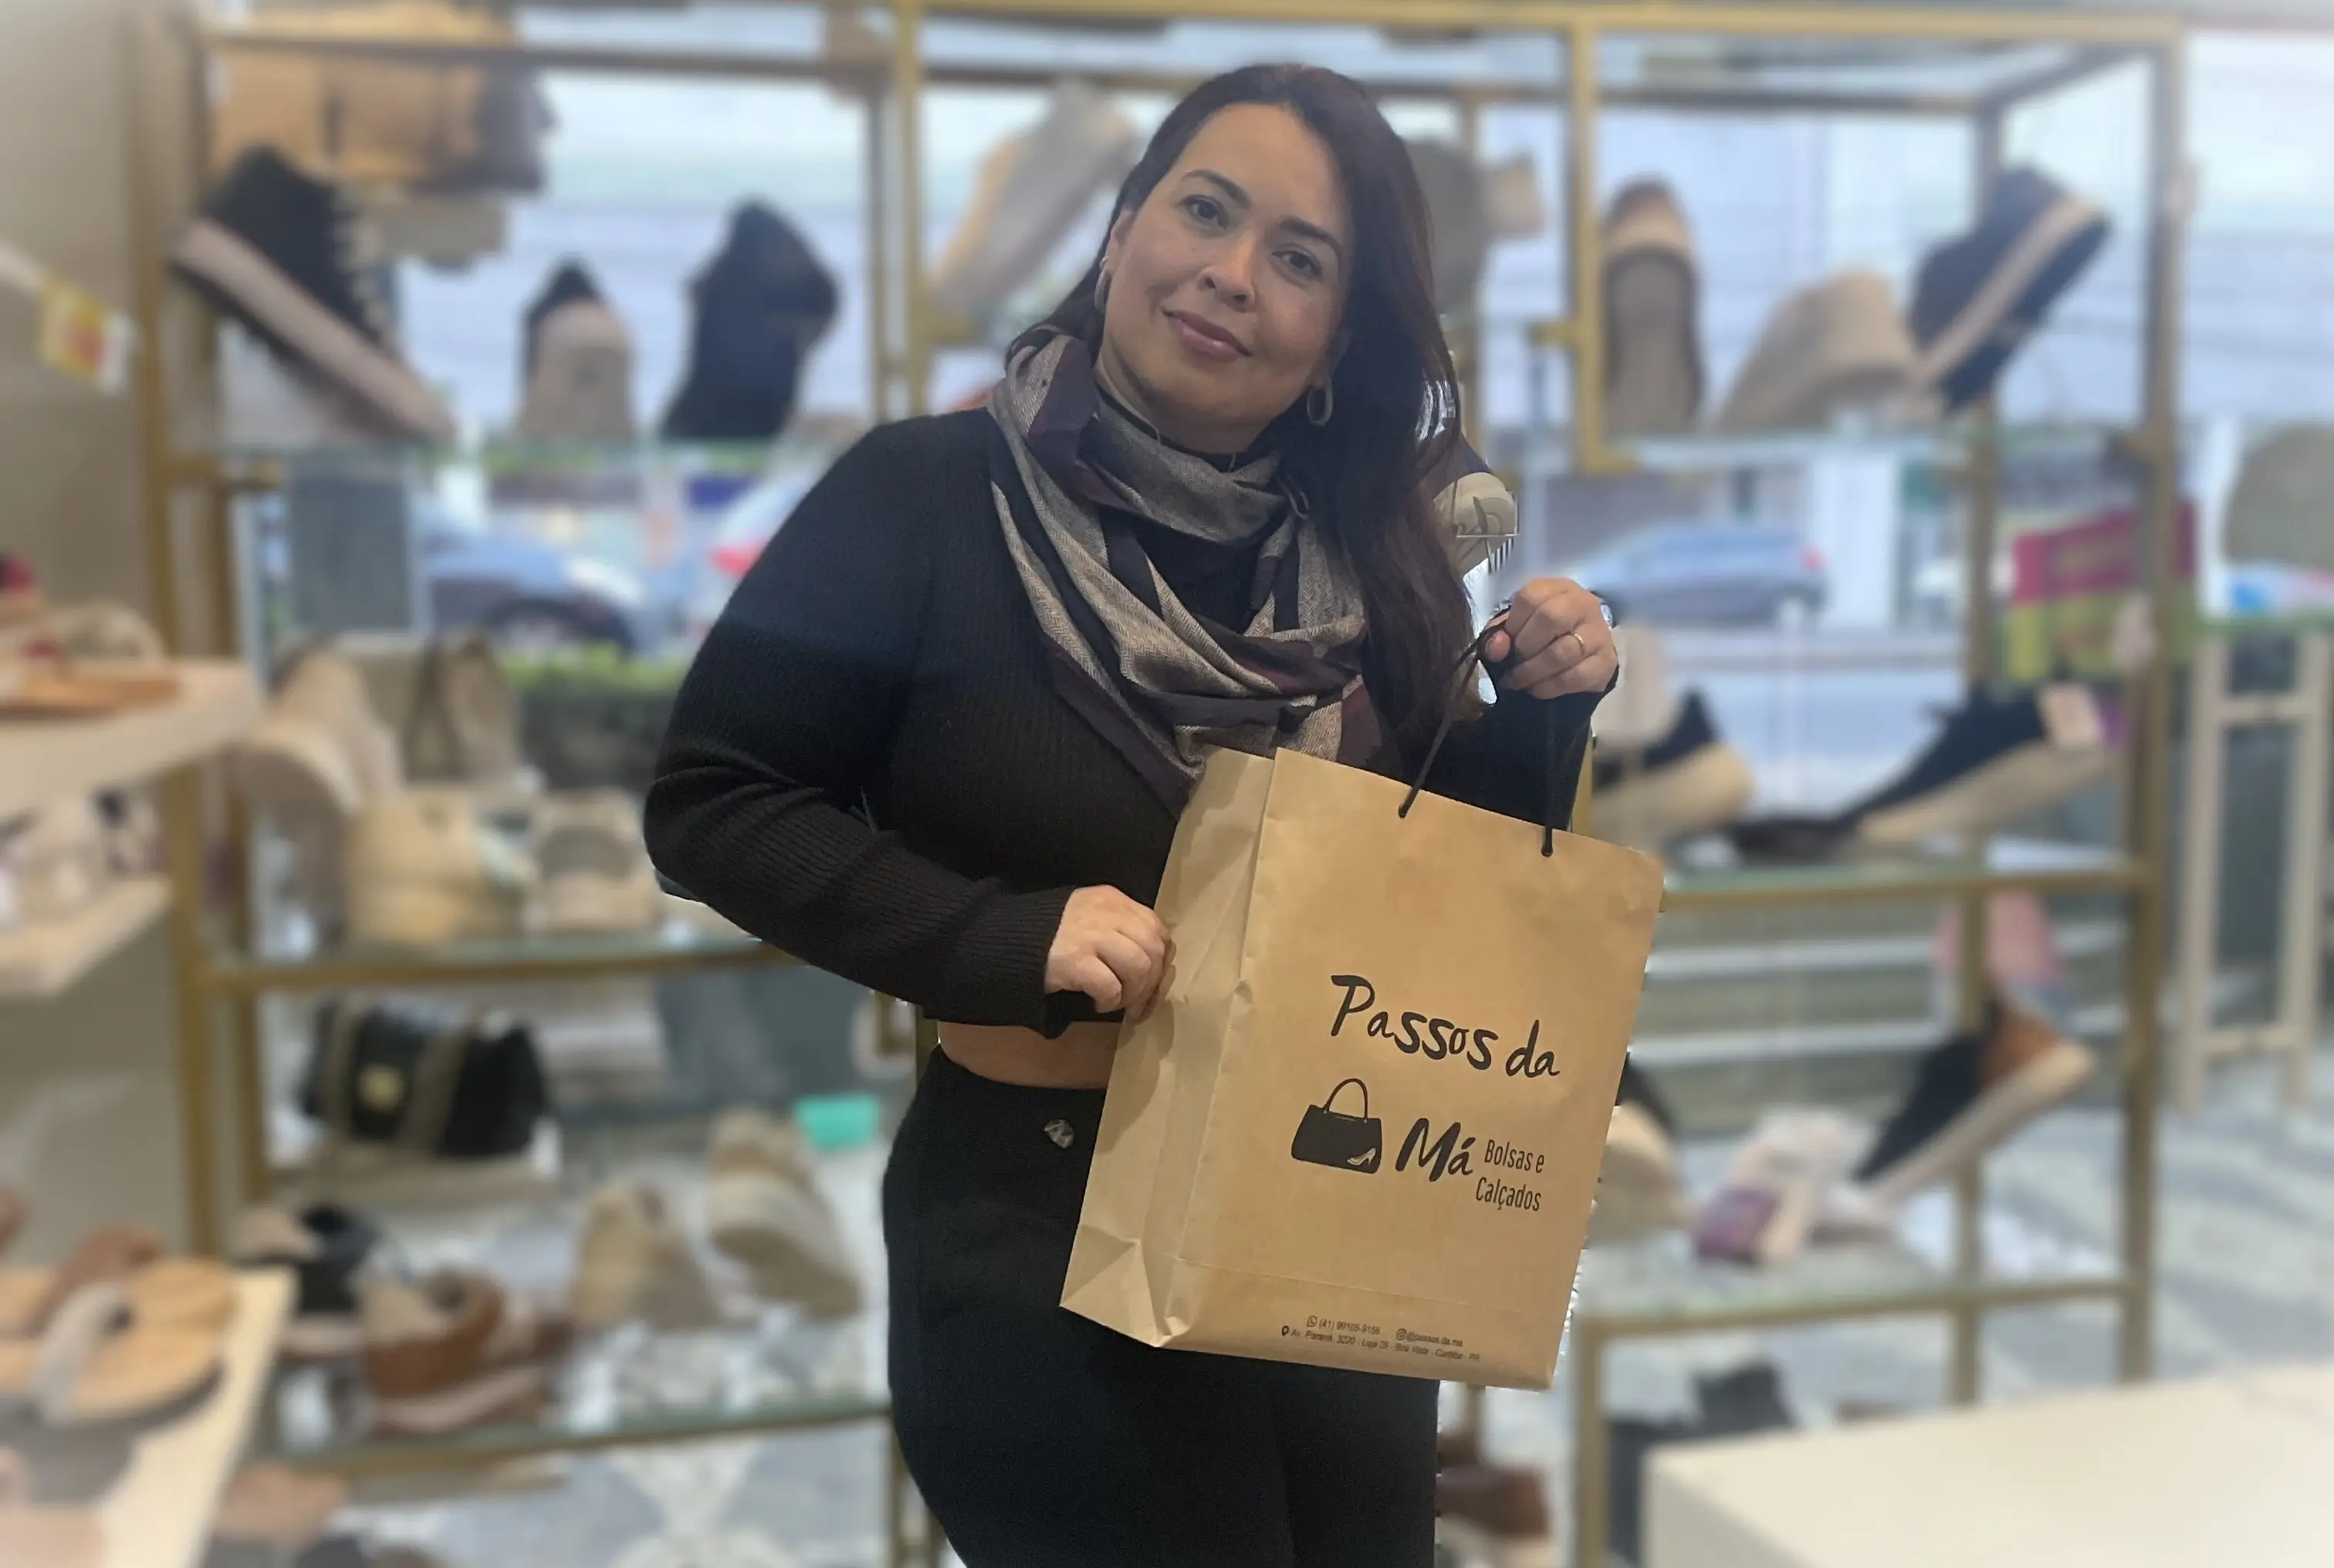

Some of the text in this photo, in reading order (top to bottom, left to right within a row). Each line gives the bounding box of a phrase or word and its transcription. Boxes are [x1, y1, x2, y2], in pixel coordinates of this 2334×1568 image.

[1331, 975, 1561, 1078] Passos da
[1395, 1118, 1476, 1181] Má
[1484, 1139, 1544, 1174] Bolsas e
[1476, 1177, 1542, 1211] Calçados
